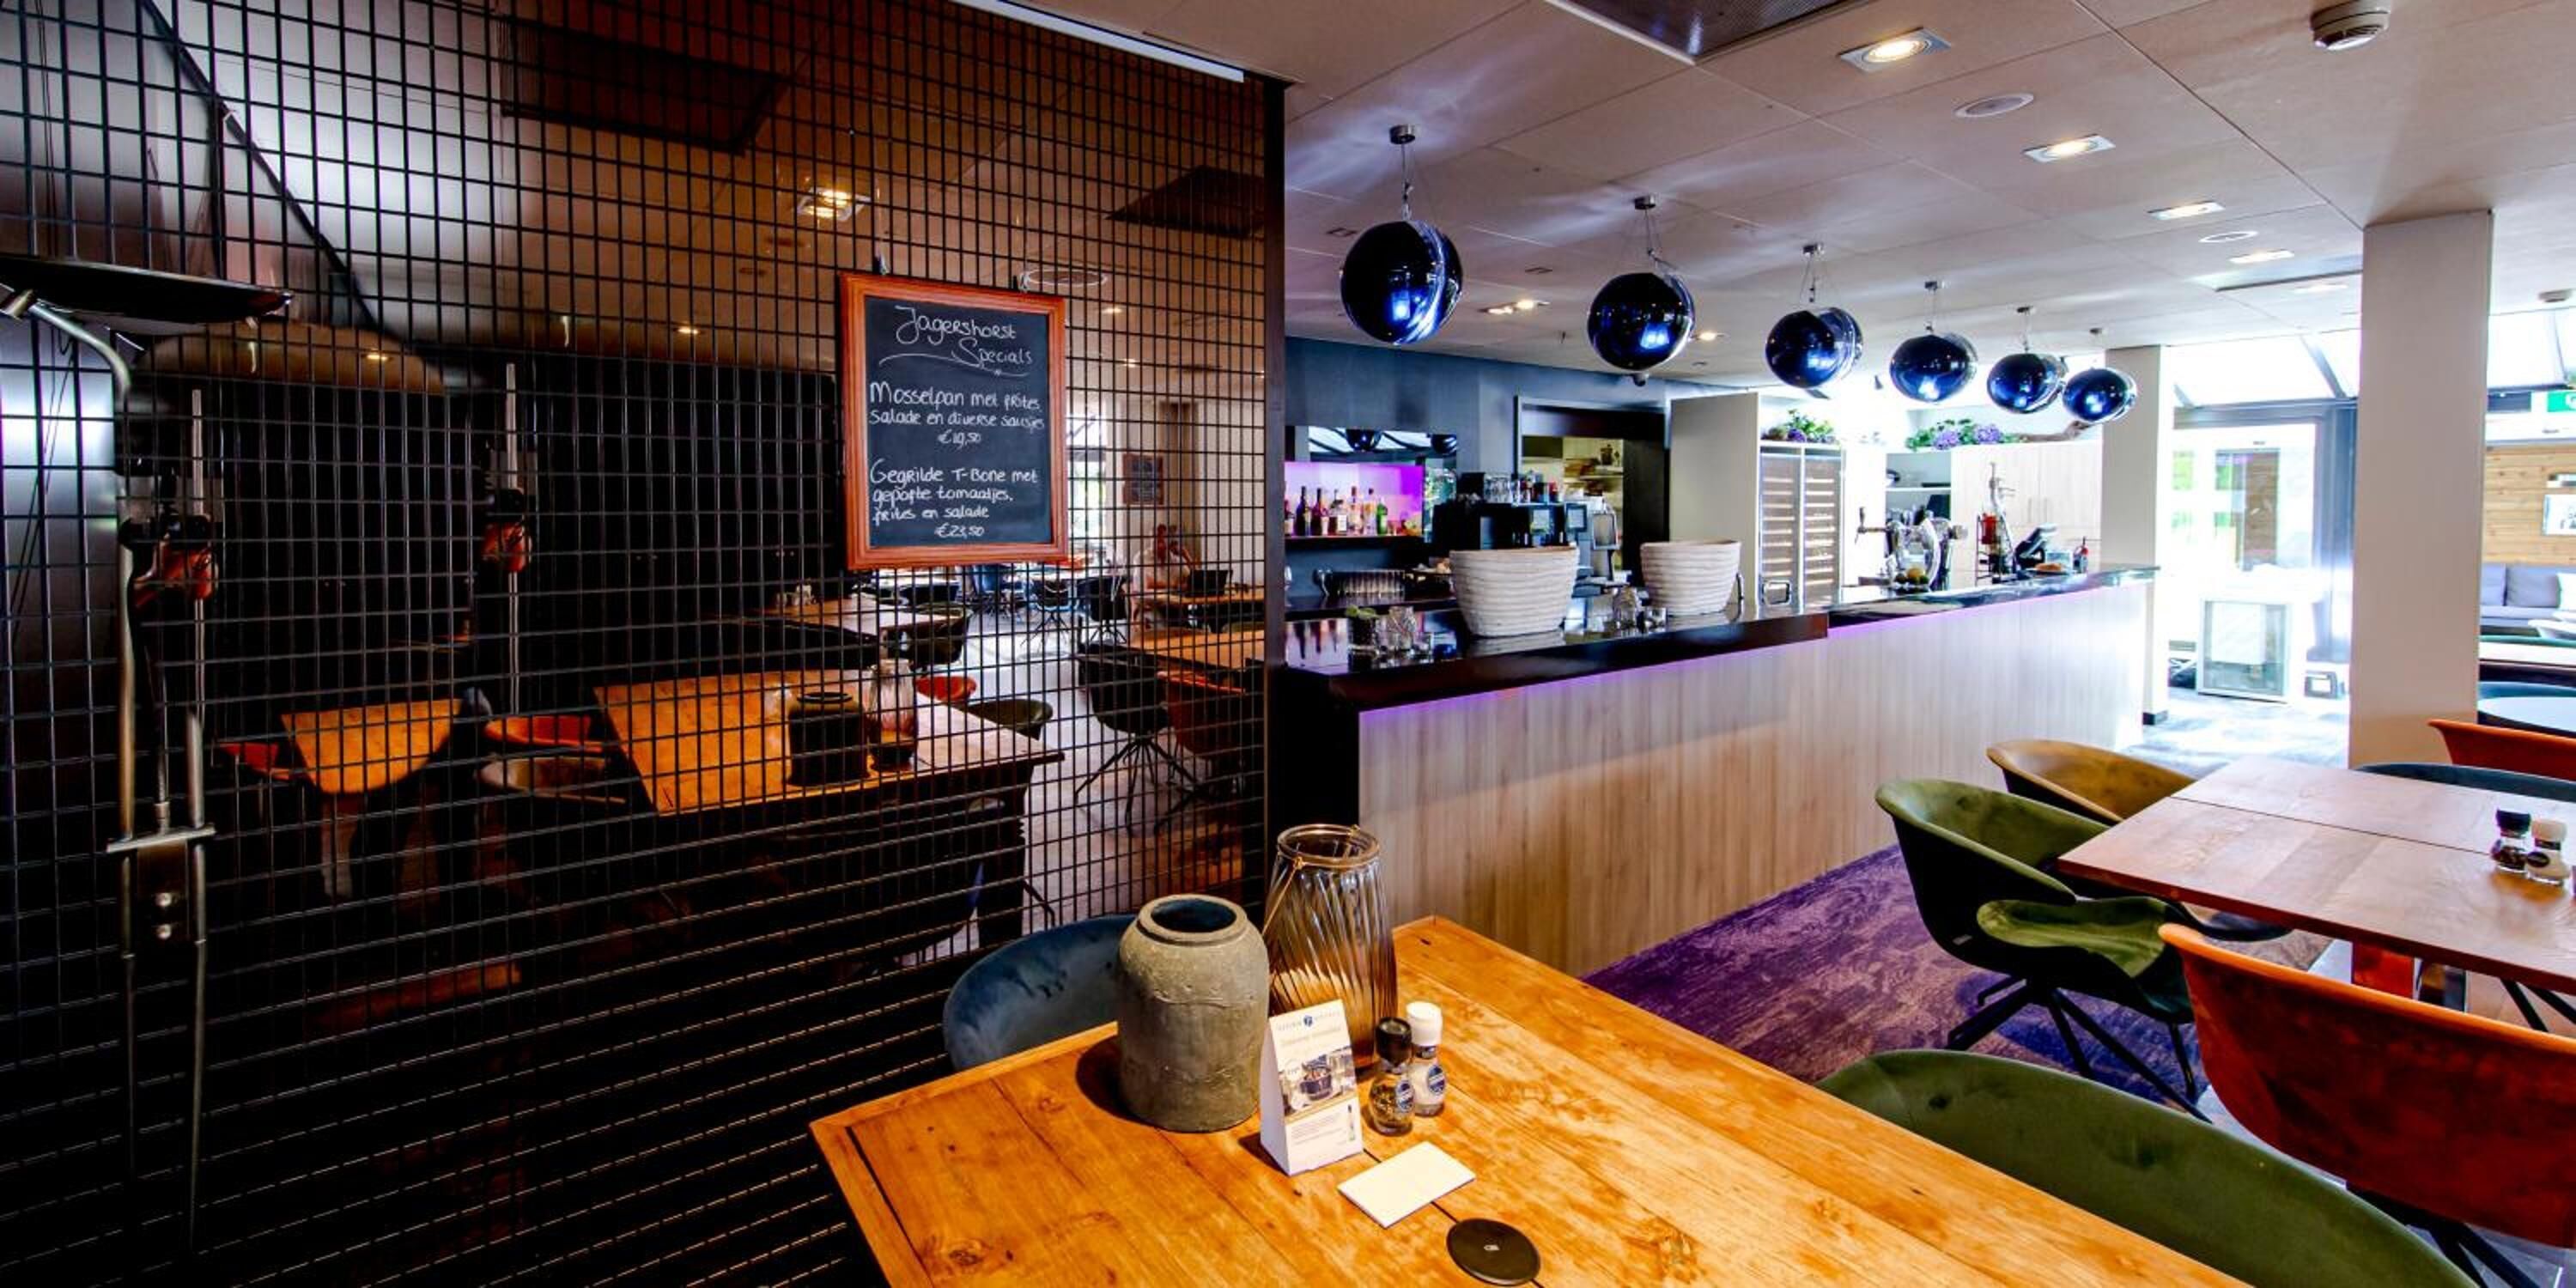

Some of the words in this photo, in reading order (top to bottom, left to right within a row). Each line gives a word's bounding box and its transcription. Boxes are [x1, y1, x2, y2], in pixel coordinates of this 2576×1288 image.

[895, 305, 1017, 345] Jagershorst
[951, 337, 1033, 370] Specials
[870, 381, 964, 410] Mosselpan
[971, 392, 998, 407] met
[927, 412, 944, 425] en
[947, 411, 997, 426] diverse
[870, 459, 943, 488] Gegrilde
[951, 468, 1005, 482] T-Bone
[1012, 469, 1038, 483] met
[921, 508, 939, 519] en
[944, 505, 990, 519] salade
